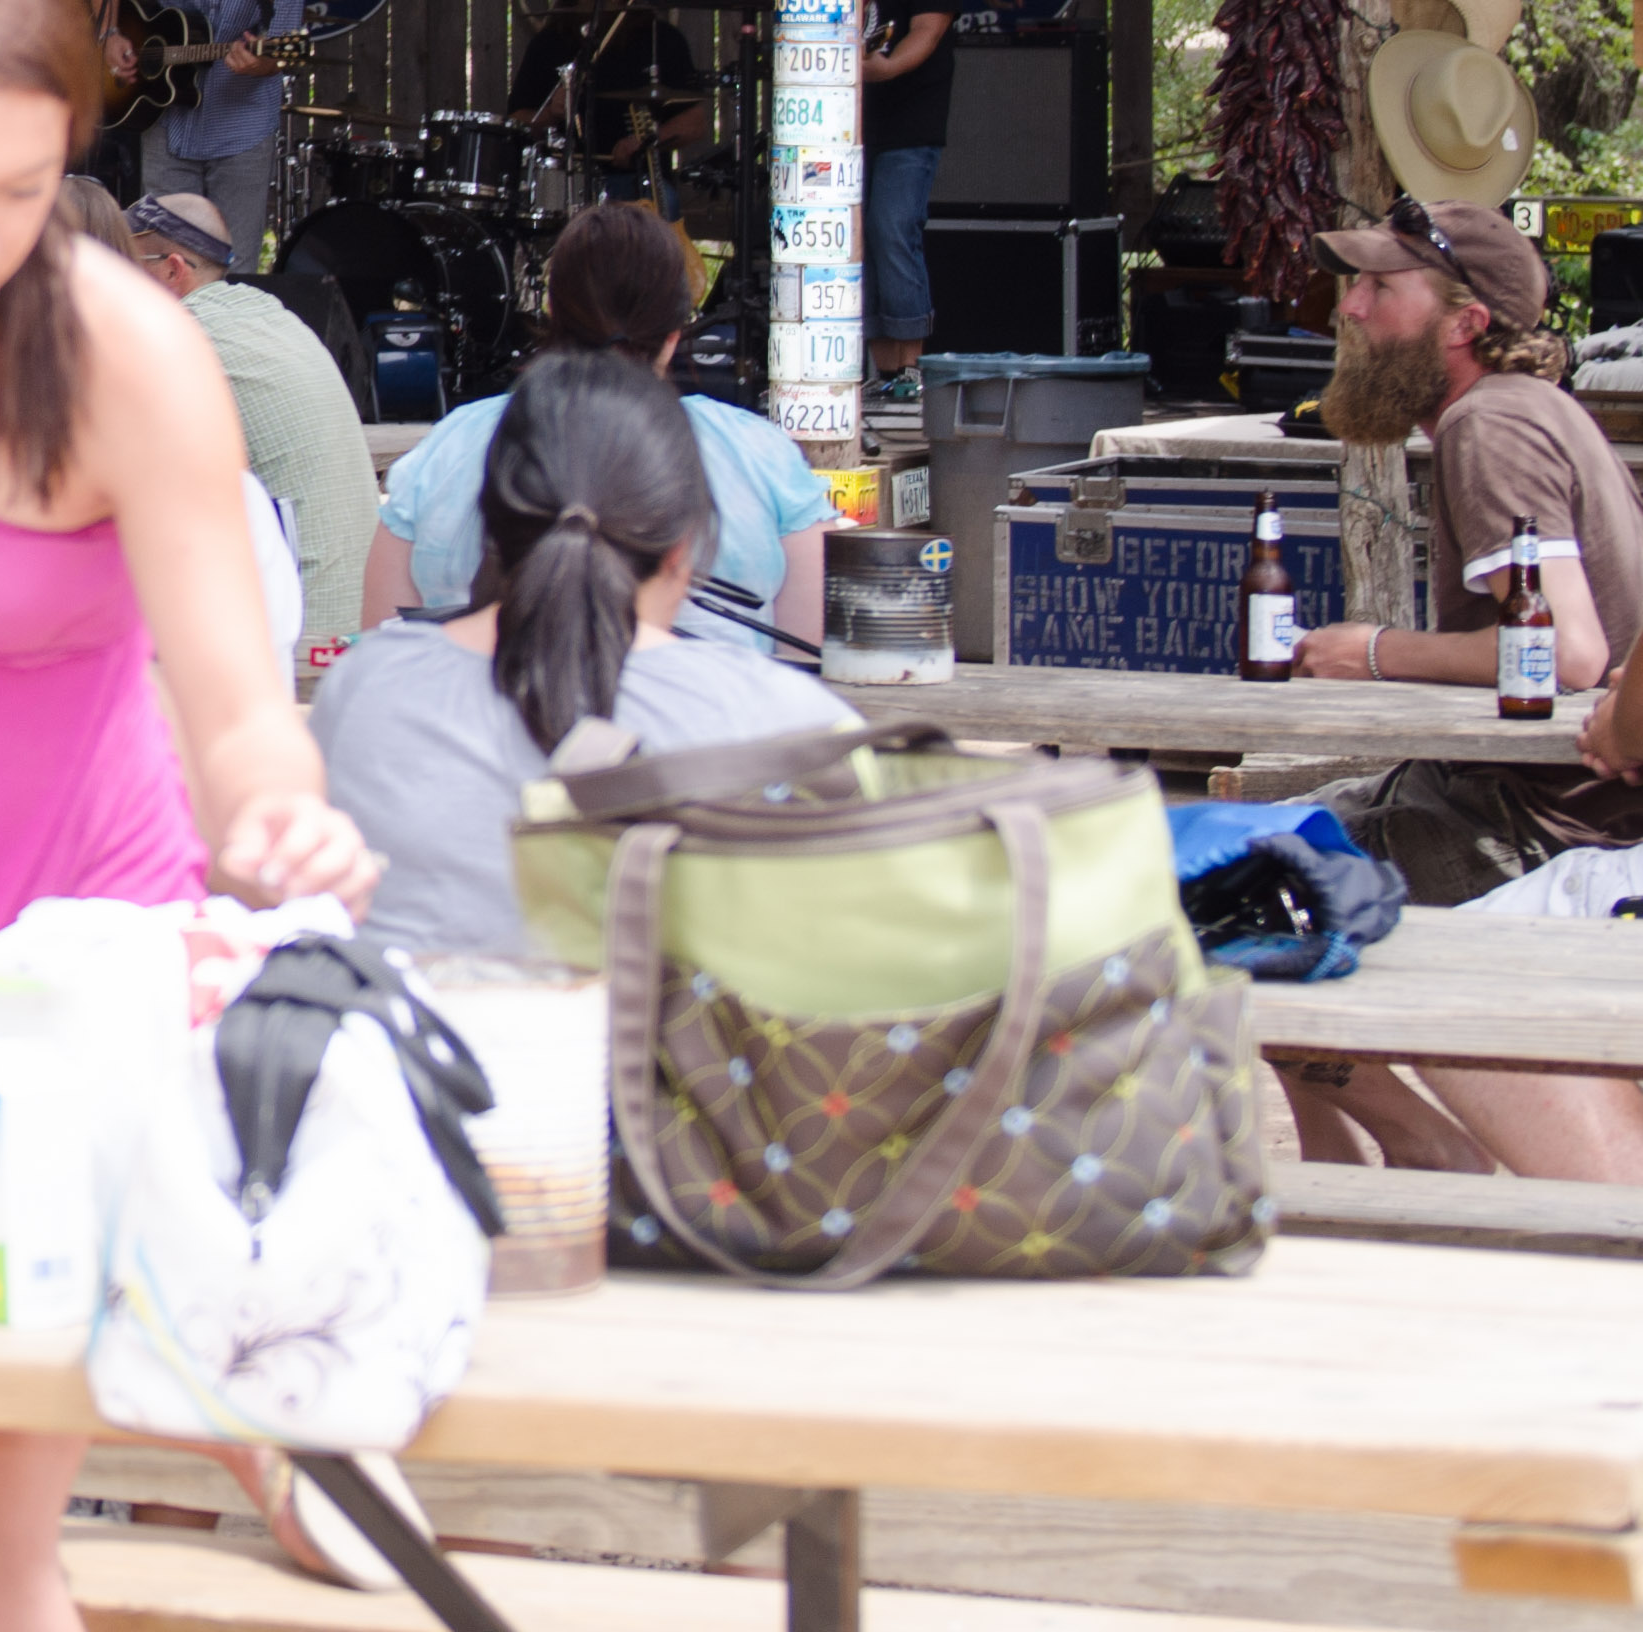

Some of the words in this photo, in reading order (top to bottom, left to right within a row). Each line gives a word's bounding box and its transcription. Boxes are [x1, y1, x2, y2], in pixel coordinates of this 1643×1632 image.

[781, 13, 828, 22] DELAWARE
[787, 210, 806, 218] TRK
[792, 221, 845, 248] 6550
[1014, 575, 1125, 614] SHOW
[1135, 617, 1240, 660] BACK
